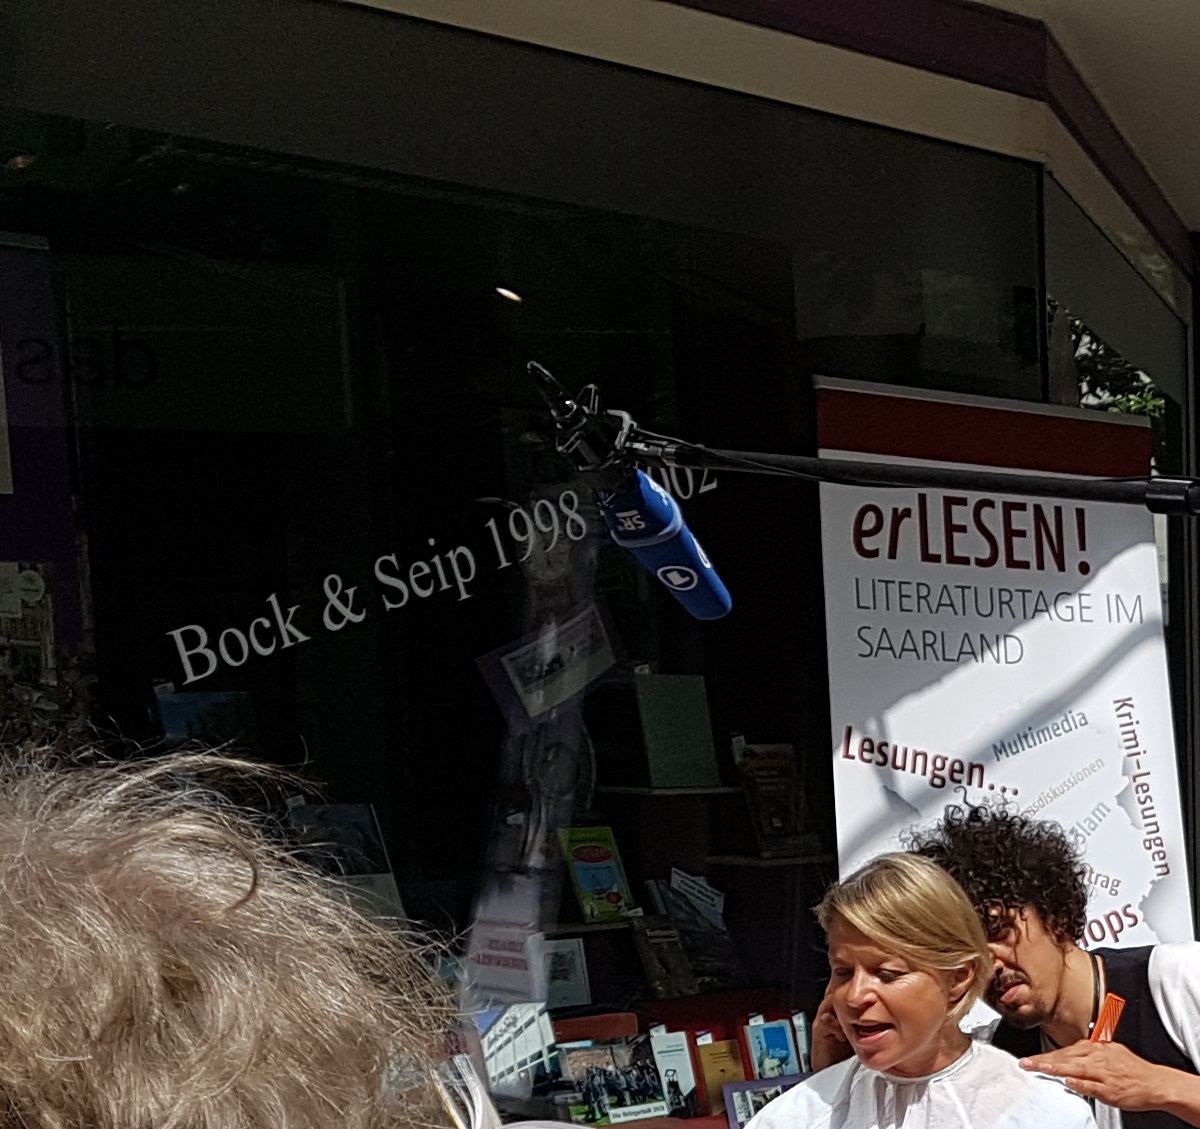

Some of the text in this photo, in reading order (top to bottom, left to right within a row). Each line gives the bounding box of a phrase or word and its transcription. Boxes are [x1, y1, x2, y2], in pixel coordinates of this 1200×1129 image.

[852, 492, 1091, 577] erLESEN!
[165, 592, 311, 686] Bock
[321, 573, 367, 632] &
[373, 537, 477, 612] Seip
[484, 489, 588, 570] 1998
[854, 577, 1144, 625] LITERATURTAGE IM
[857, 625, 1024, 665] SAARLAND
[841, 725, 1019, 797] Lesungen...
[991, 708, 1089, 763] Multimedia
[1113, 696, 1171, 878] Krimi-Lesungen
